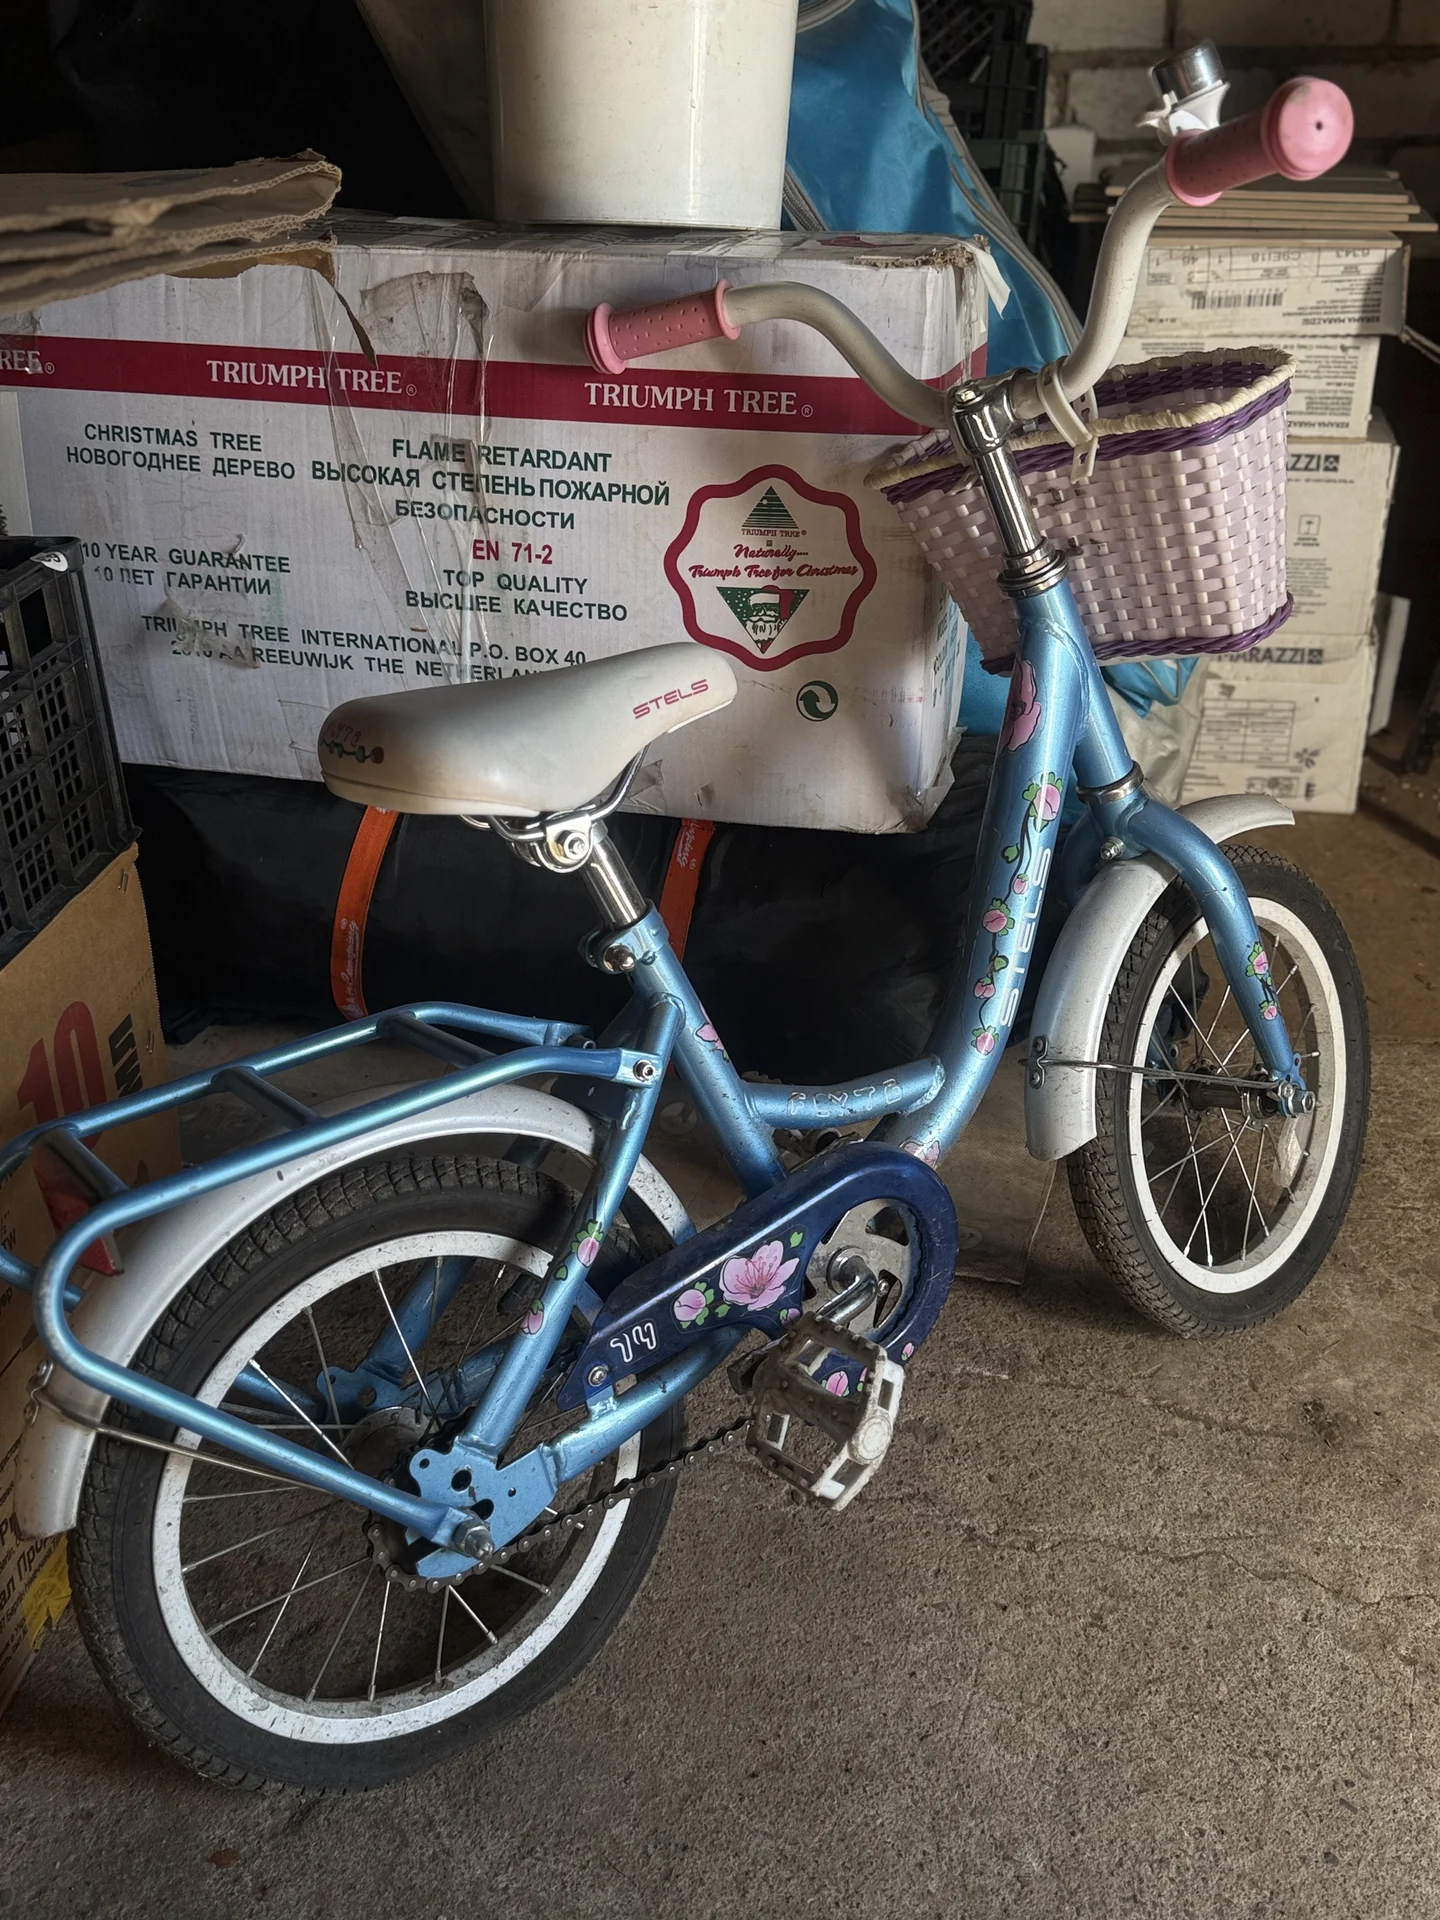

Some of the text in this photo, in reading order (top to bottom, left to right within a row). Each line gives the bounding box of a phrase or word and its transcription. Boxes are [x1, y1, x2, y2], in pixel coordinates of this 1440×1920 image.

[206, 359, 402, 395] TRIUMPH TREE
[584, 382, 797, 416] TRIUMPH TREE
[84, 423, 262, 452] CHRISTMAS TREE
[66, 446, 295, 480] НОВОГОДНЕЕ ДЕРЕВО
[392, 438, 612, 473] FLAME RETARDANT
[1286, 454, 1321, 471] ZZI
[311, 461, 670, 506] ВЫСОКАЯ СТЕПЕНЬ ПОЖАРНОЙ
[395, 500, 575, 530] БЕЗОПАСНОСТИ
[83, 542, 291, 574] 10 YEAR GUARANTEE
[472, 539, 553, 564] EN 71-2
[166, 571, 271, 596] ГАРАНТИИ
[443, 569, 588, 595] TOP QUALITY
[688, 565, 742, 581] Triumph
[405, 590, 628, 622] ВЫСШЕЕ КАЧЕСТВО
[238, 623, 290, 645] TREE
[300, 628, 461, 658] INTERNATIONAL
[470, 641, 509, 661] P.O.
[515, 645, 559, 666] BOX
[563, 650, 586, 667] 40
[252, 647, 354, 671] REEUWIJK
[367, 655, 404, 675] THE
[632, 678, 709, 720] STELS
[999, 845, 1053, 1028] STELS
[609, 1320, 659, 1364] 14
